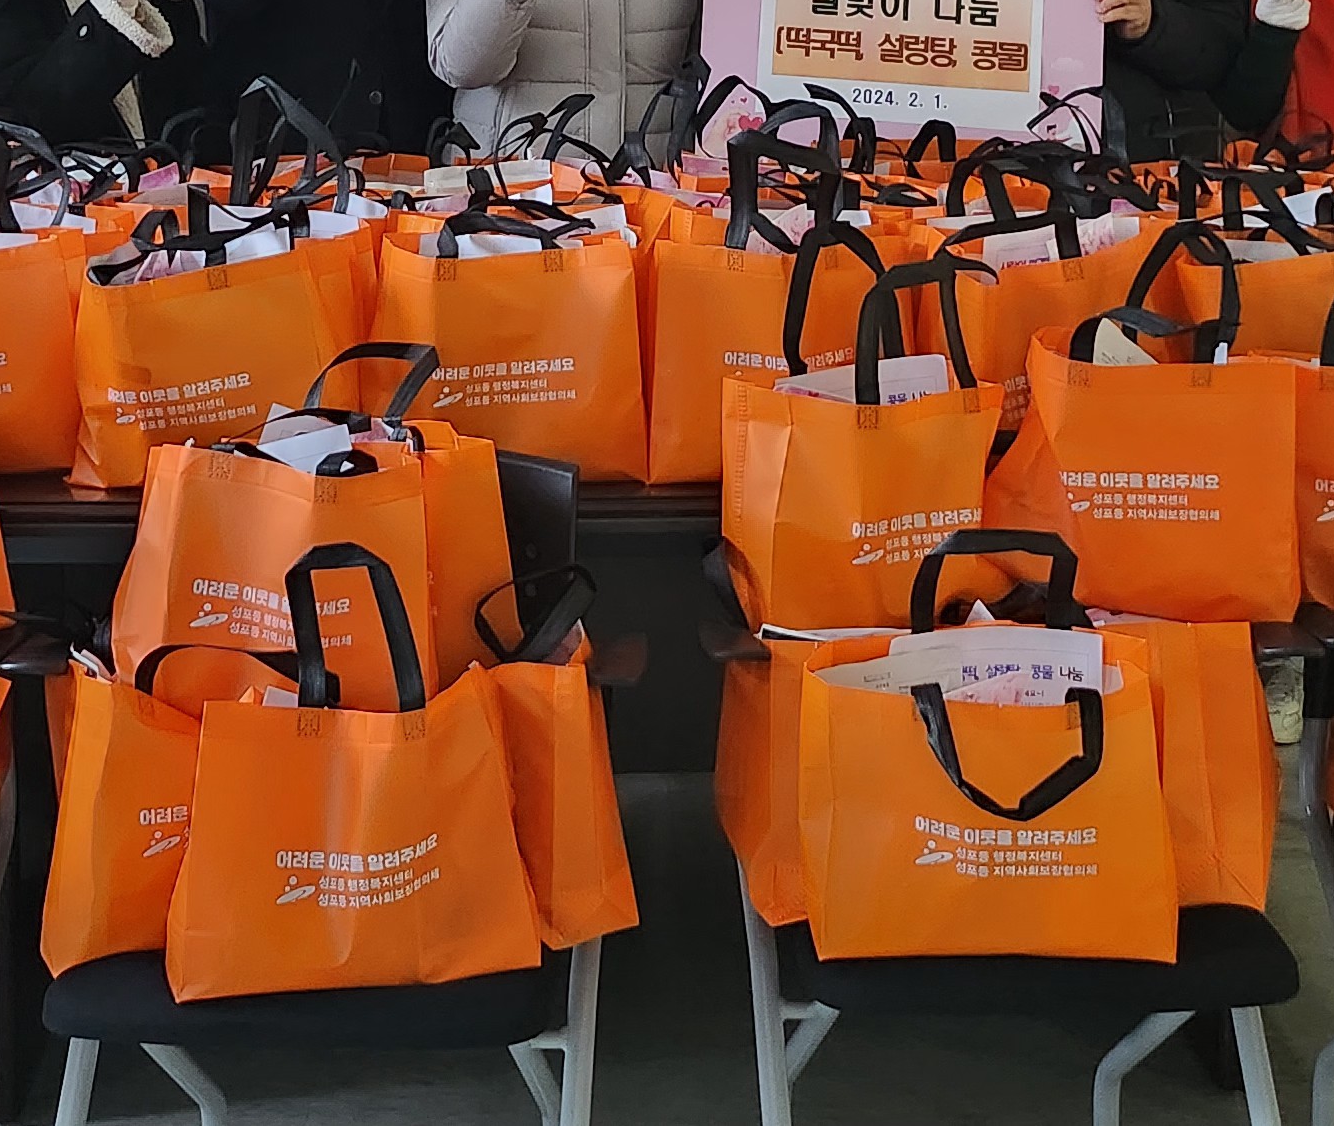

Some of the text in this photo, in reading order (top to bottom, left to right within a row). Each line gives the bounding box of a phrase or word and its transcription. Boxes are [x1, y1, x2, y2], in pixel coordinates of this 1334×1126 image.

[852, 88, 947, 108] 2024. 2. 1.
[430, 358, 574, 381] 어려운 이웃을 알려주세요
[725, 351, 762, 367] 어려운
[140, 387, 180, 403] 이웃을
[183, 373, 251, 398] 알려주세요
[1100, 472, 1143, 488] 이웃을
[1147, 473, 1219, 489] 알려주세요
[852, 519, 889, 538] 어려운
[891, 513, 926, 531] 이웃을
[193, 578, 239, 597] 어려운
[243, 587, 279, 610] 이웃을
[1060, 666, 1083, 682] 나눔
[139, 805, 188, 826] 어려운
[915, 816, 1097, 845] 어려운 이웃을 알려주세요
[276, 833, 438, 872] 어려운 이웃을 알려주세요
